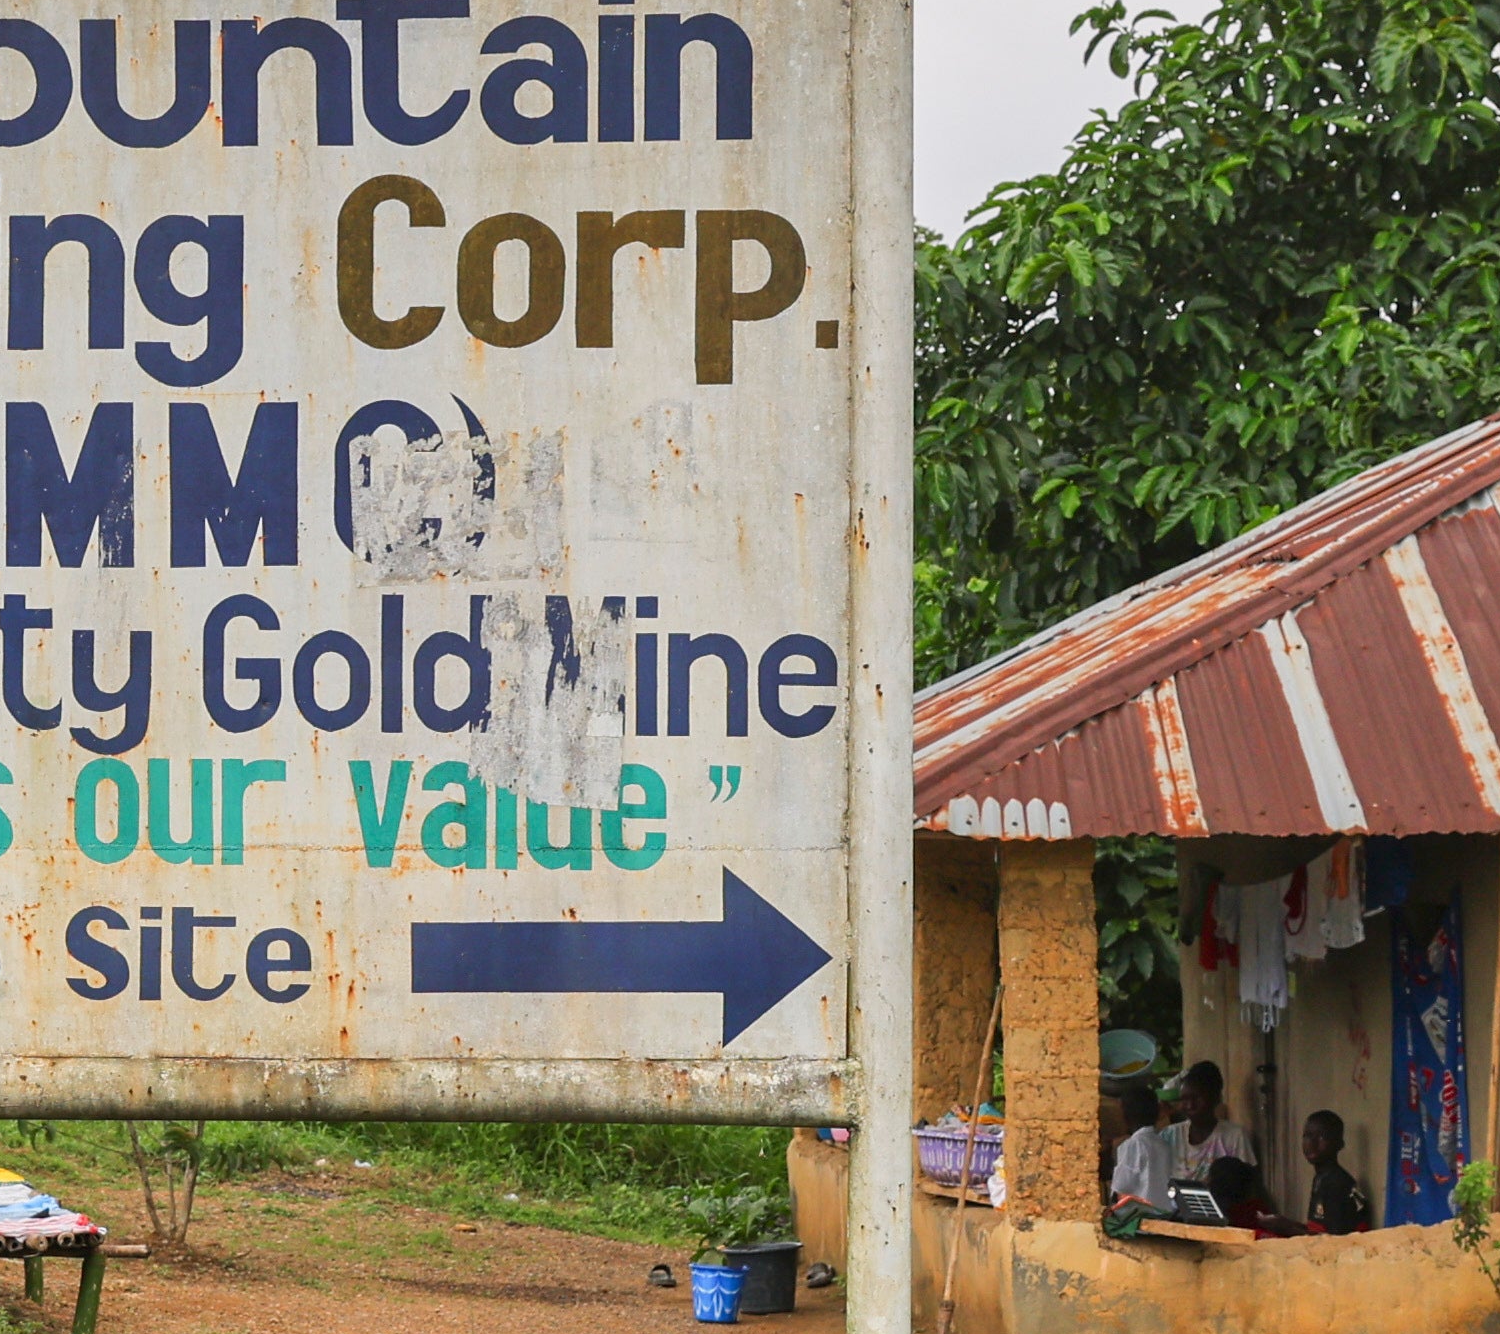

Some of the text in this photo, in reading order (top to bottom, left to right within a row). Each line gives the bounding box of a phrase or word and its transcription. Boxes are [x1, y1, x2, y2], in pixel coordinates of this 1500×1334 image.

[337, 174, 840, 385] Corp.
[202, 593, 493, 734] Gold
[74, 757, 288, 866] our
[65, 906, 312, 1002] Site
